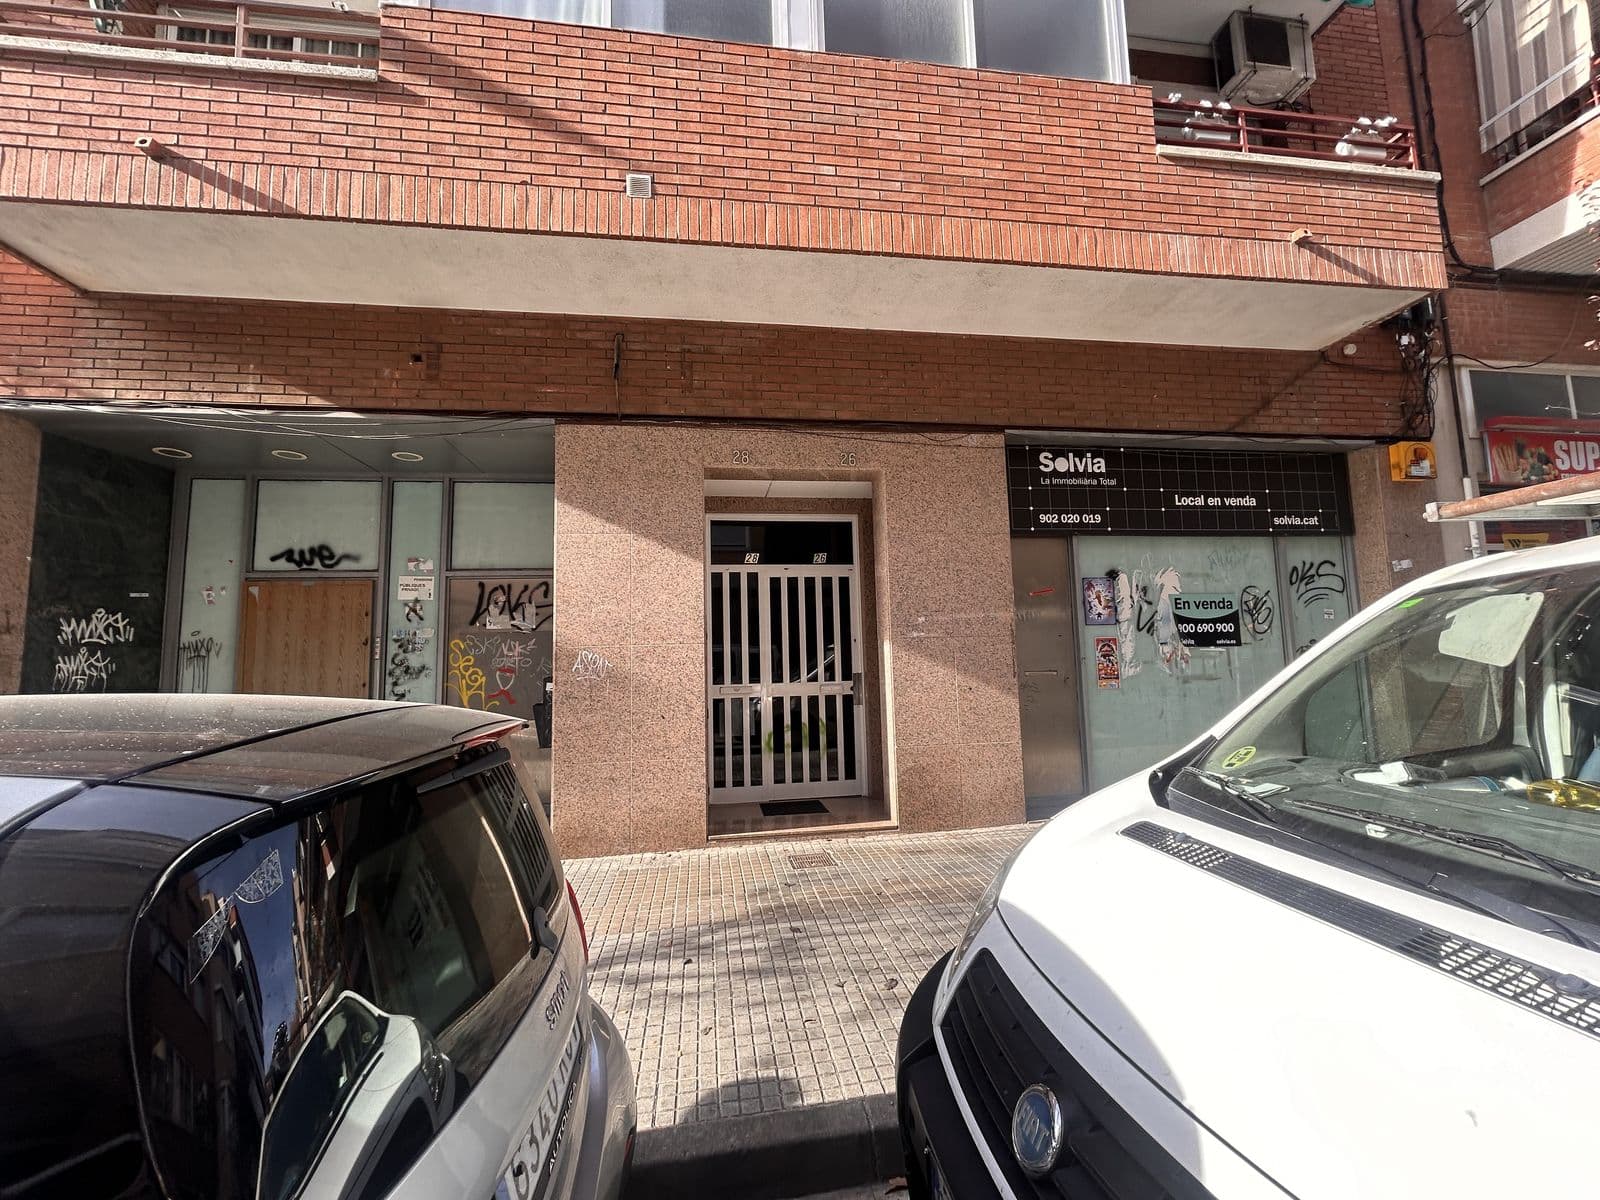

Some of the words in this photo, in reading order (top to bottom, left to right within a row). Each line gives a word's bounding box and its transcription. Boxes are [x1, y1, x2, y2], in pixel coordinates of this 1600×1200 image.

[732, 450, 749, 464] 28
[840, 453, 857, 466] 26
[1554, 440, 1600, 471] SUP
[1039, 452, 1106, 473] Solvia
[1040, 477, 1050, 485] La
[1099, 477, 1117, 486] Total
[1174, 494, 1205, 506] Local
[1207, 498, 1222, 506] en
[1224, 495, 1257, 506] venda
[1039, 513, 1059, 524] 902
[1061, 513, 1080, 524] 020
[1082, 513, 1102, 524] 019
[1273, 515, 1319, 525] solvia.cat
[745, 553, 759, 563] 28
[814, 553, 827, 563] 26
[1174, 597, 1191, 610] En
[1193, 597, 1234, 610] venda
[1196, 623, 1215, 633] 690
[1215, 622, 1235, 633] 900
